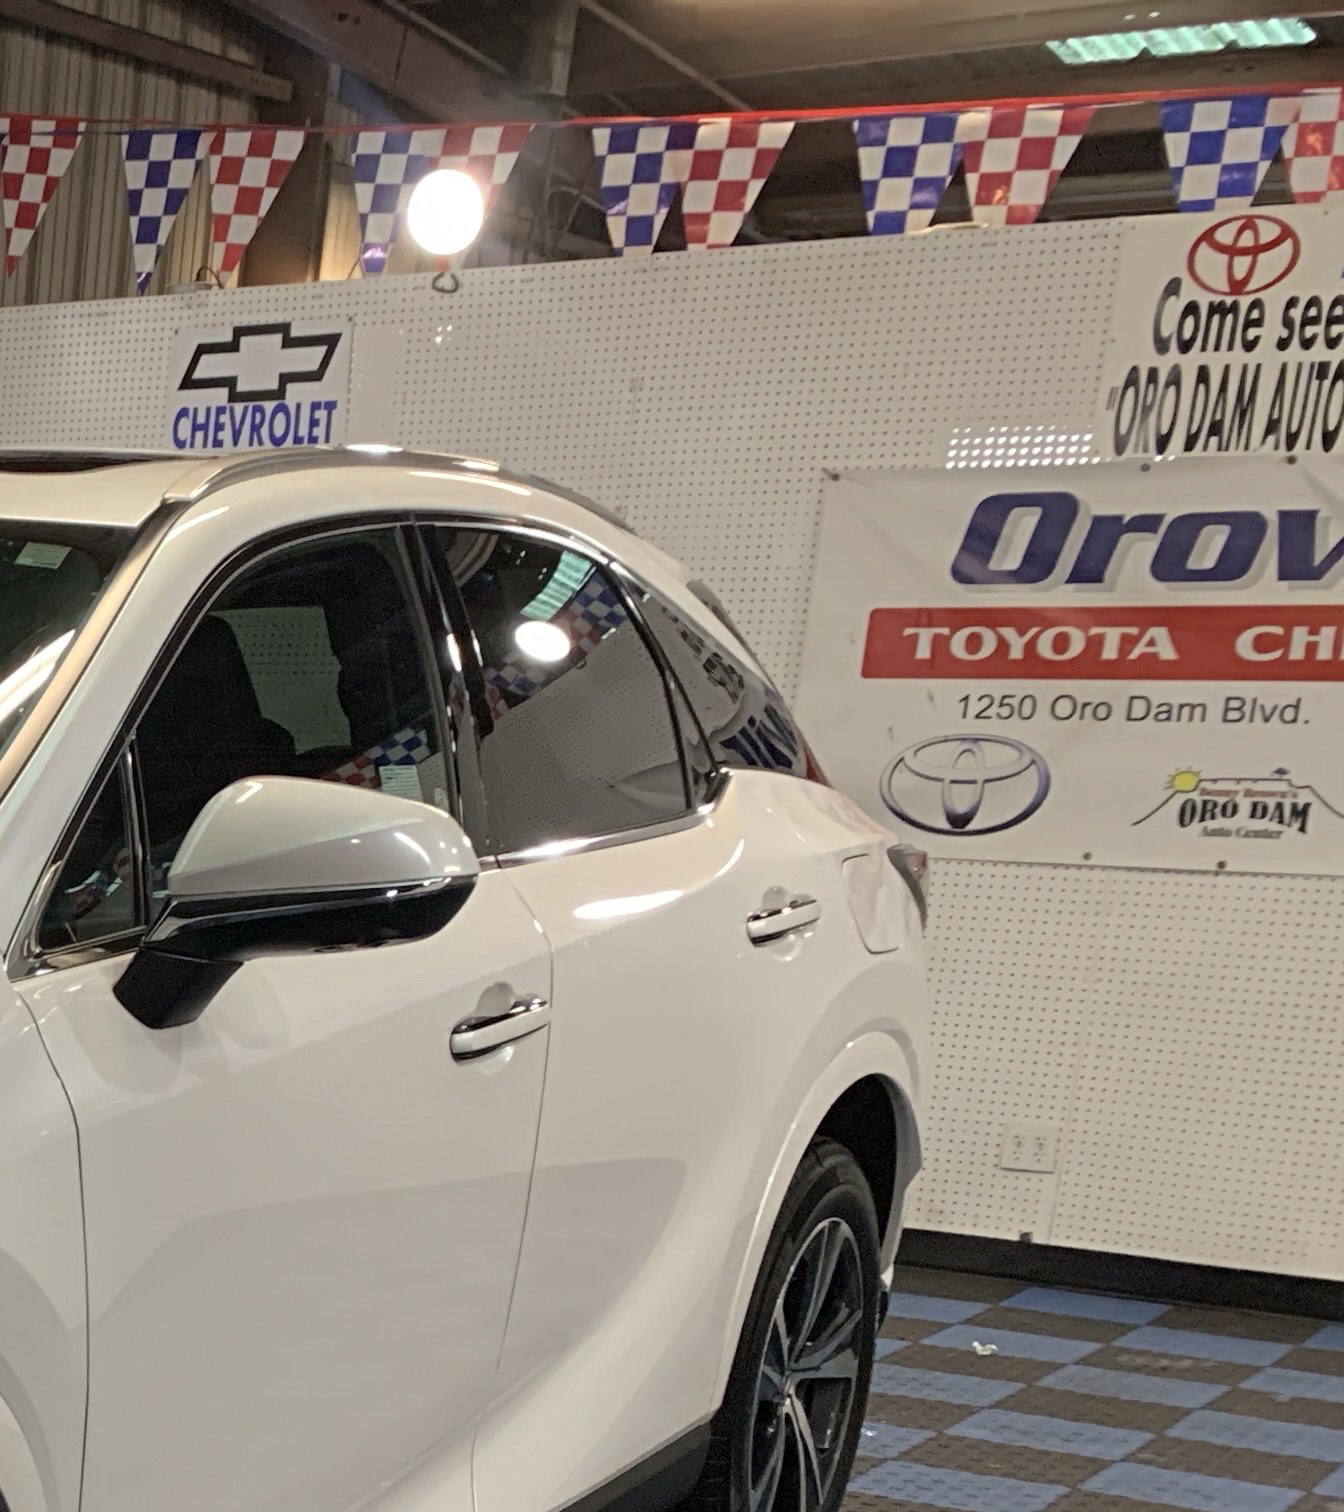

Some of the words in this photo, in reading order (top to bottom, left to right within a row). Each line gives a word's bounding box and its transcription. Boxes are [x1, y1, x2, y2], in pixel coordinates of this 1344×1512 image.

[1152, 276, 1266, 356] Come
[1275, 293, 1344, 352] see
[172, 400, 339, 450] CHEVROLET
[1105, 362, 1182, 457] "ORO
[1183, 362, 1263, 453] DAM
[1261, 357, 1344, 454] AUTO
[902, 625, 1180, 662] TOYOTA
[1234, 625, 1344, 662] CH
[957, 693, 1038, 722] 1250
[1050, 695, 1113, 723] Oro
[1126, 695, 1208, 724] Dam
[1221, 696, 1311, 726] Blvd.
[1177, 797, 1240, 828] ORO
[1248, 800, 1312, 834] DAM
